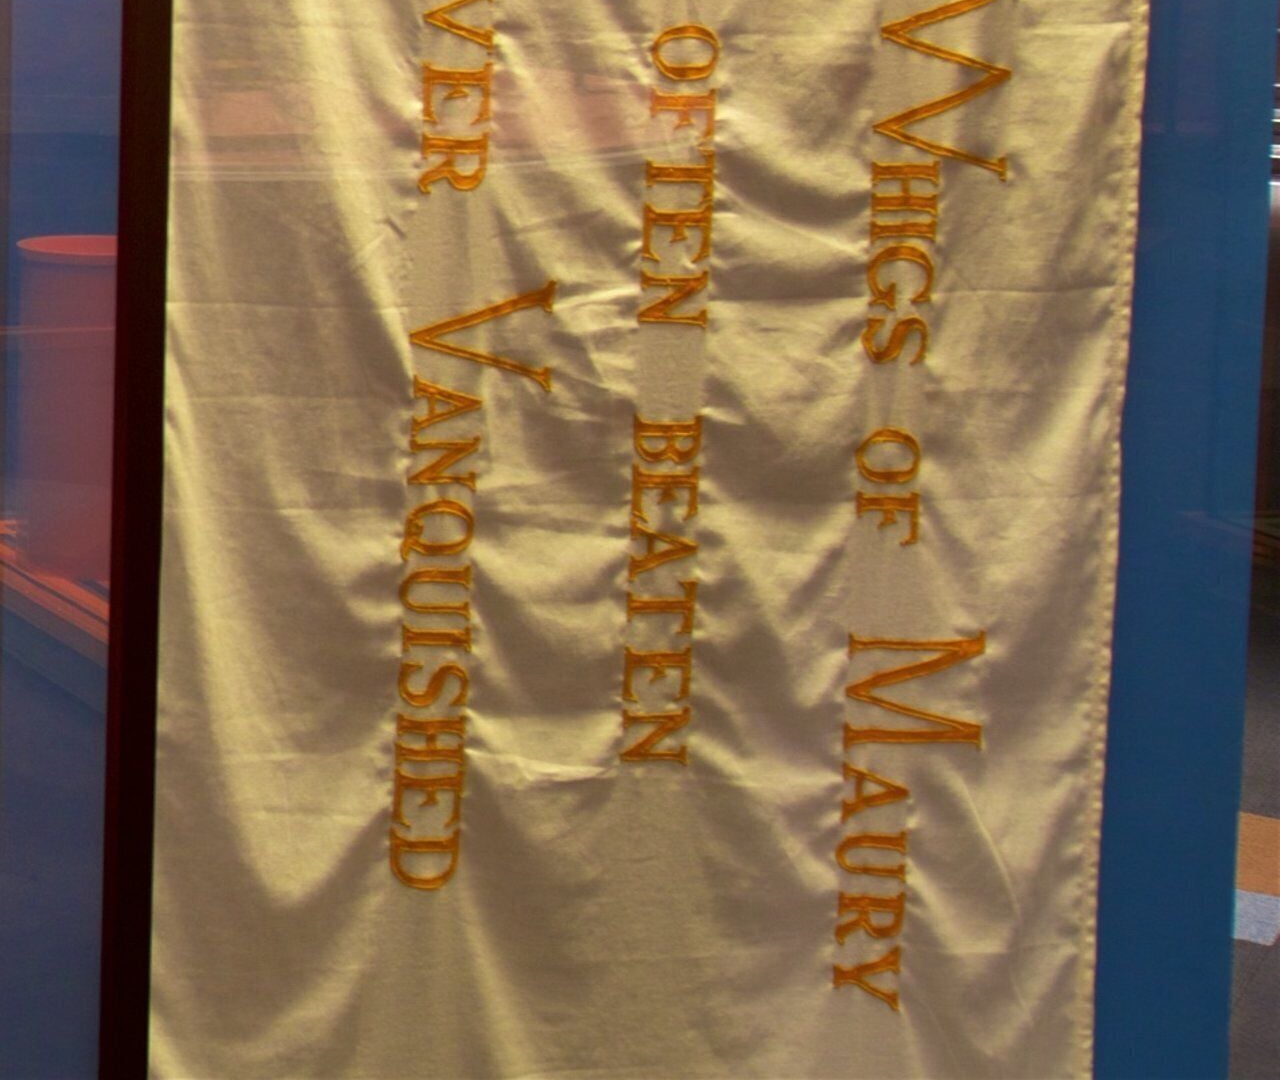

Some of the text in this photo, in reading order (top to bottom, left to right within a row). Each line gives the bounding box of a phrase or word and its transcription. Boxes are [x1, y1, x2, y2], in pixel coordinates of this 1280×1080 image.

[619, 24, 719, 765] OFTEN BEATEN
[855, 427, 920, 545] OF
